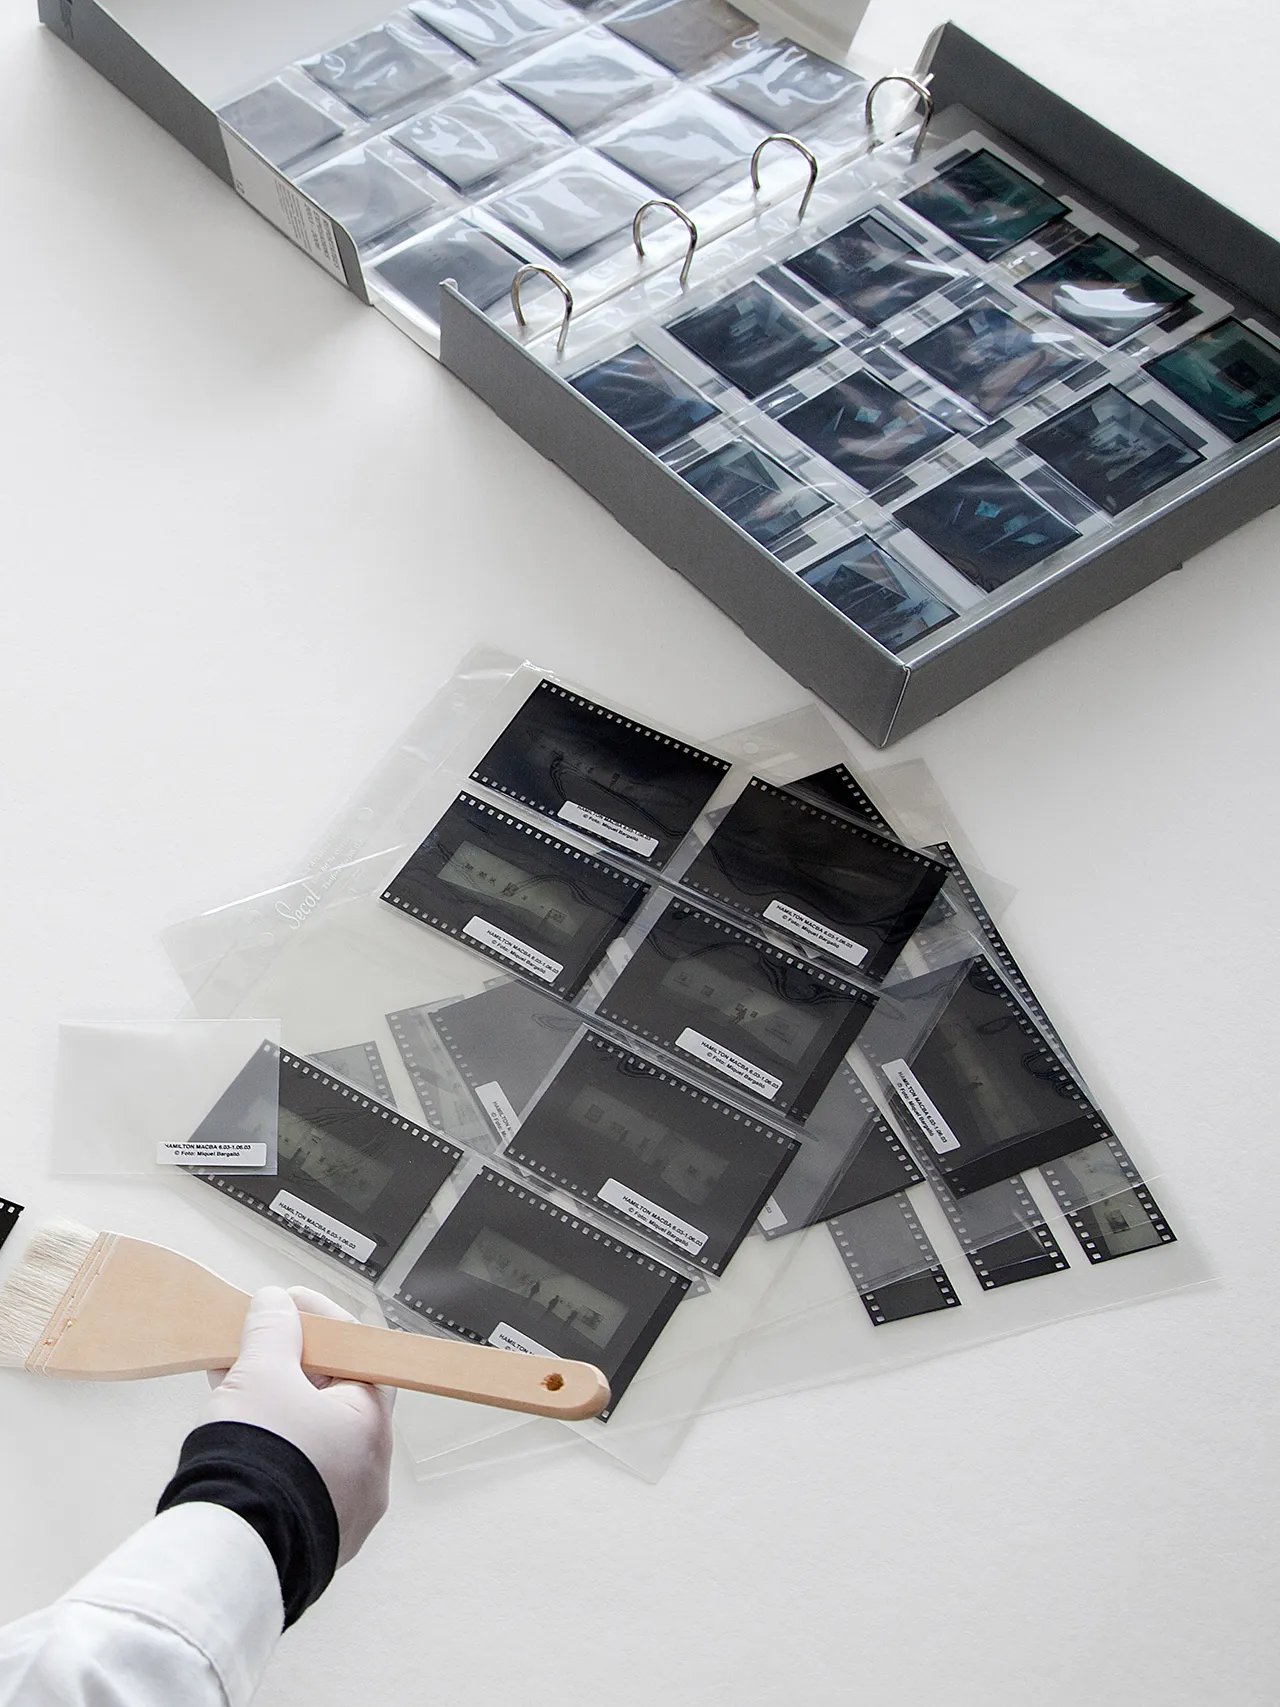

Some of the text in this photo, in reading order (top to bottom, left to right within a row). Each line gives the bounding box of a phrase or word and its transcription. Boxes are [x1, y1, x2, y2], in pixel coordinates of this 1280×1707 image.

[600, 821, 618, 833] Miquel
[275, 882, 323, 930] Secol
[775, 904, 804, 922] HAMILTON
[803, 918, 824, 933] MACBA
[485, 929, 513, 947] HAMILTON
[511, 944, 531, 958] MACBA
[800, 924, 819, 938] Miquel
[508, 949, 526, 963] Miquel
[700, 1040, 729, 1060] HAMILTON
[728, 1056, 750, 1072] MACBA
[725, 1063, 744, 1077] Miquel
[897, 1070, 917, 1098] HAMILTON
[914, 1095, 929, 1116] MACBA
[906, 1099, 921, 1118] Miquel
[277, 1200, 307, 1221] HAMILTON
[305, 1216, 327, 1232] MACBA
[621, 1194, 652, 1215] HAMILTON
[650, 1212, 673, 1228] MACBA
[647, 1219, 667, 1233] Miquel
[497, 1332, 529, 1354] HAMILTON
